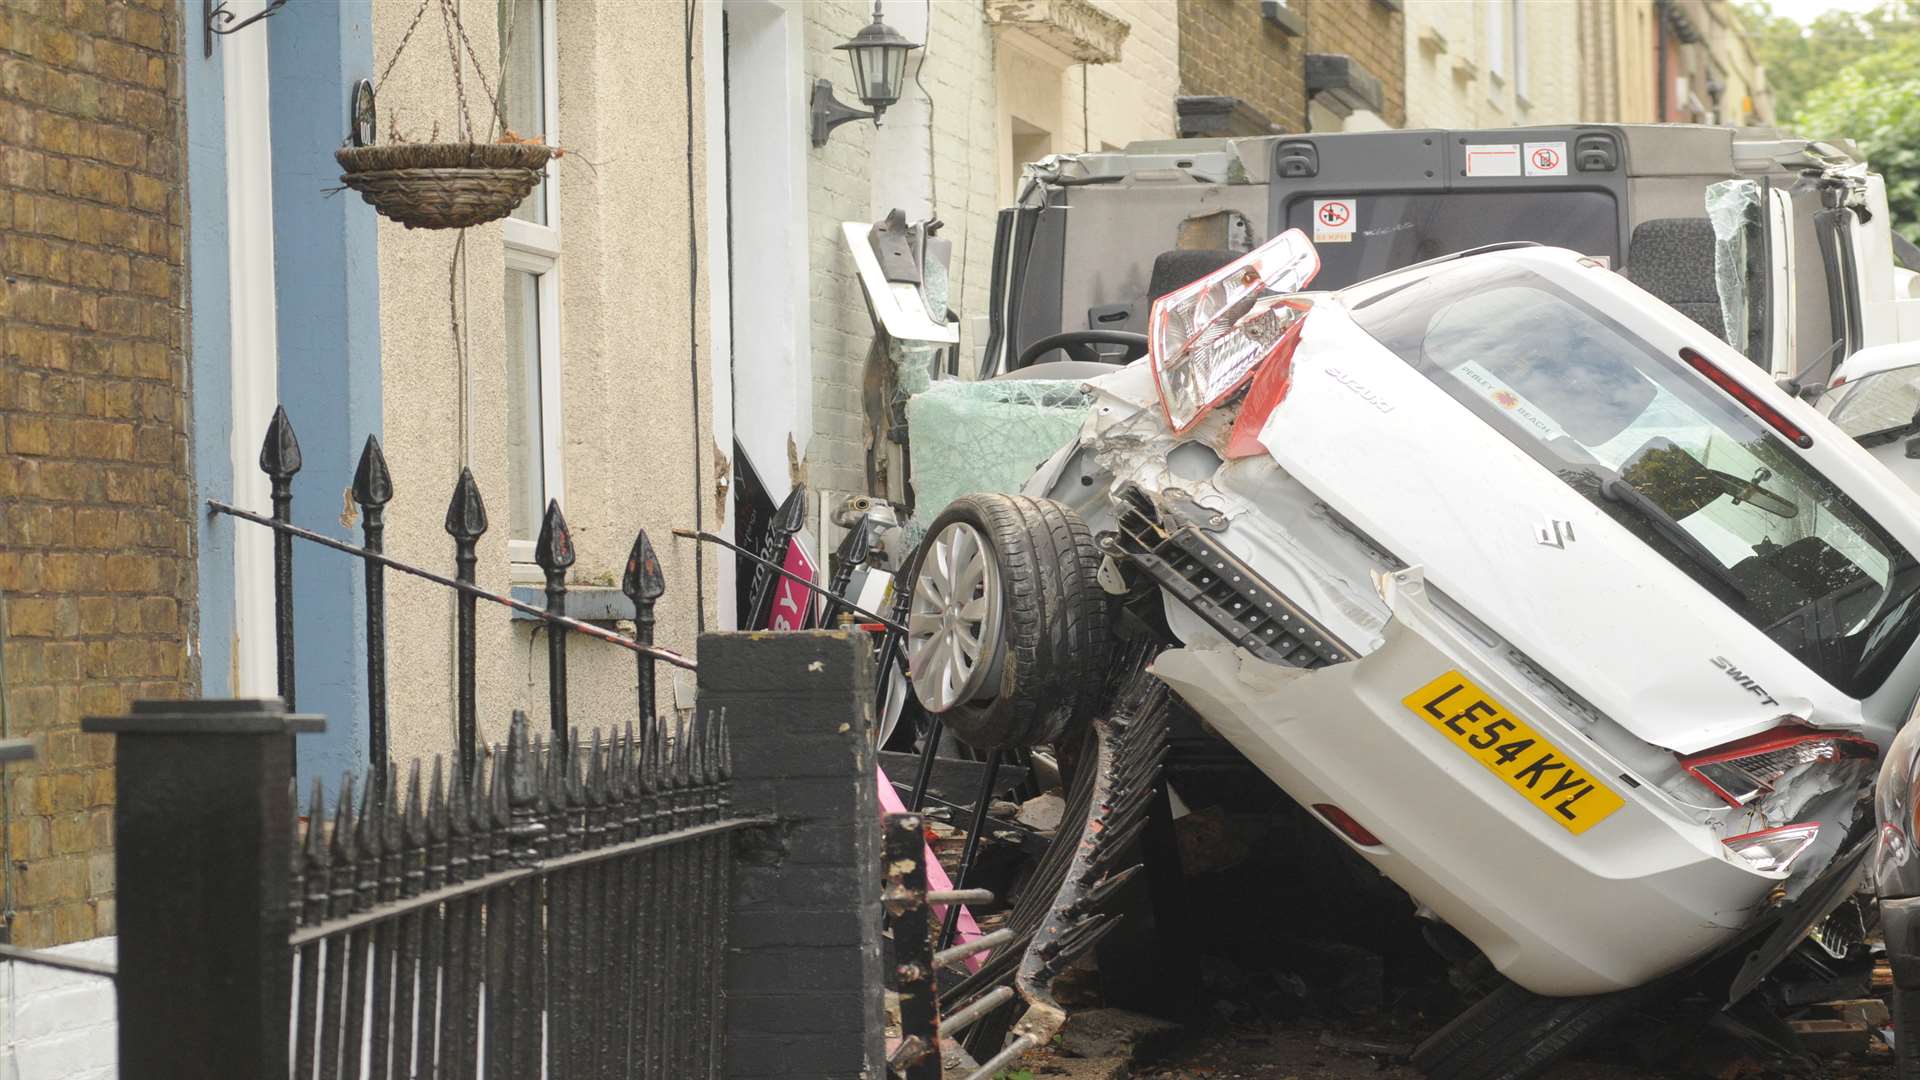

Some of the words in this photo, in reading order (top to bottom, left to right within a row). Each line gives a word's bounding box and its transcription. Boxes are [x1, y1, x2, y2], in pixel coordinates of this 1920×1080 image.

[1325, 367, 1396, 414] SUZUKI
[1516, 407, 1552, 434] BEACH
[1709, 655, 1780, 707] SWIFT
[1422, 684, 1536, 766] LE54
[1513, 753, 1595, 821] KYL
